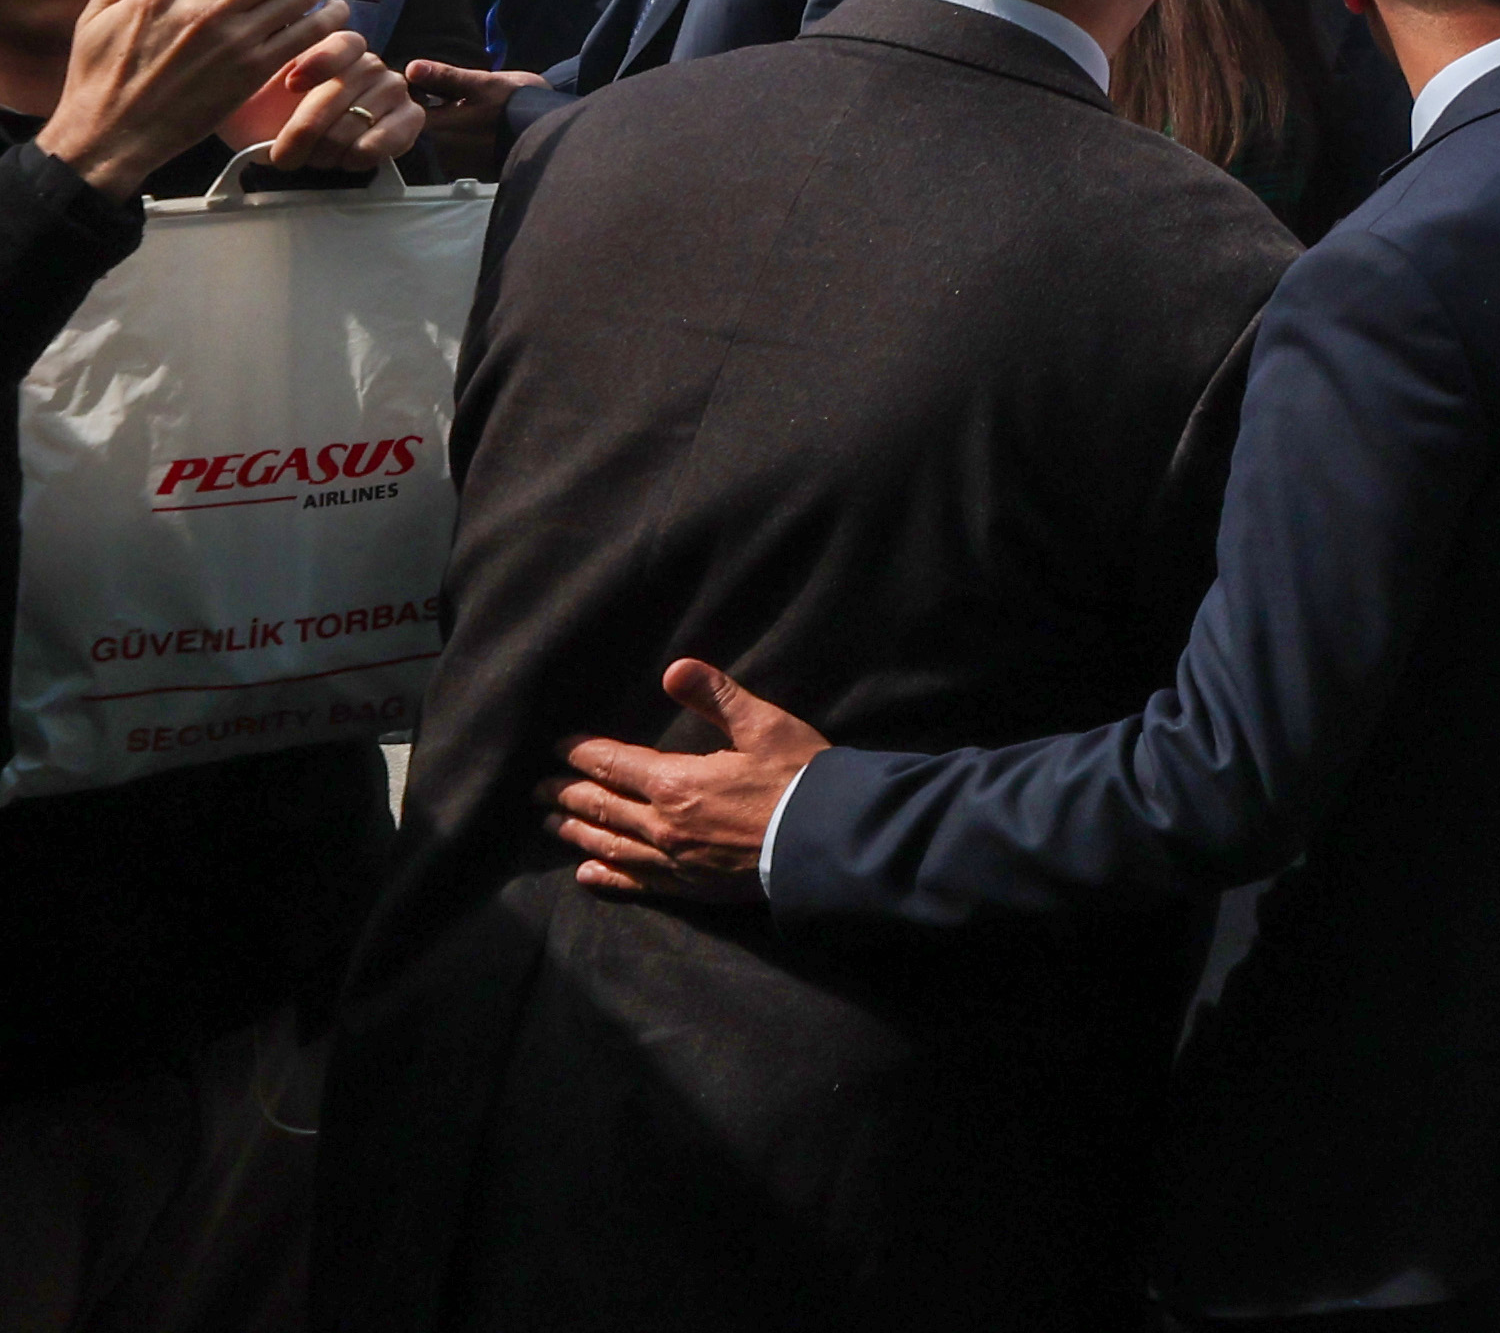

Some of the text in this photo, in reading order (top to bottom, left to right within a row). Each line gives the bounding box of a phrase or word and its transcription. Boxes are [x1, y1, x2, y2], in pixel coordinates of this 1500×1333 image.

[155, 434, 424, 496] PEGASUS
[303, 483, 399, 510] AIRLINES
[90, 617, 285, 663] GÜVENLİK
[126, 697, 407, 754] SECURITY BAG
